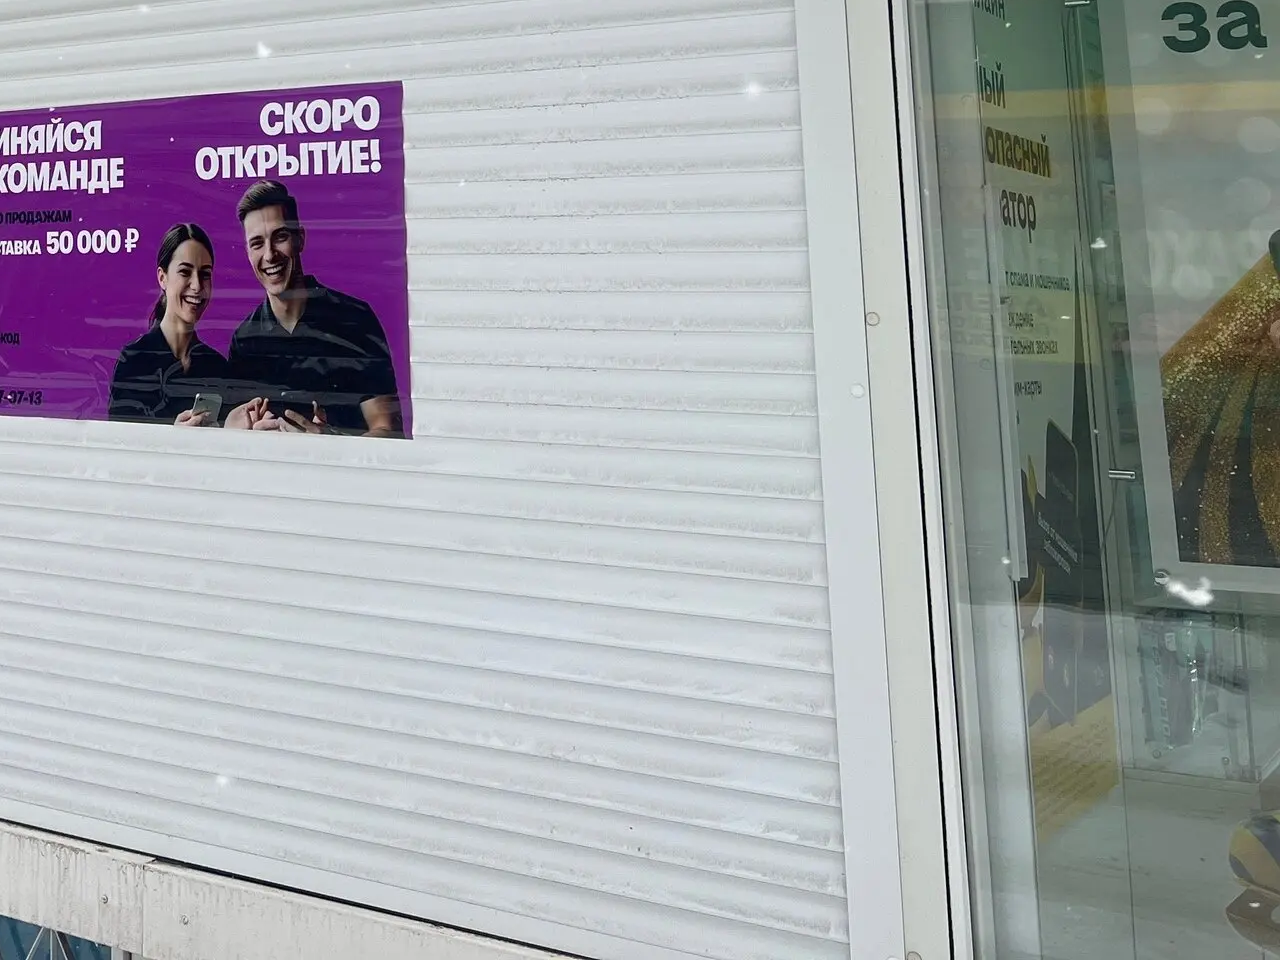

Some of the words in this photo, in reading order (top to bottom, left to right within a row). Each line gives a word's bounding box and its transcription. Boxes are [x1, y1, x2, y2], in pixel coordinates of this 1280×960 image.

[1161, 0, 1268, 53] за
[259, 96, 380, 136] СКОРО
[195, 139, 382, 180] ОТКРЫТИЕ!
[5, 209, 72, 225] ПРОДАЖАМ
[46, 230, 75, 254] 50
[76, 229, 121, 254] 000
